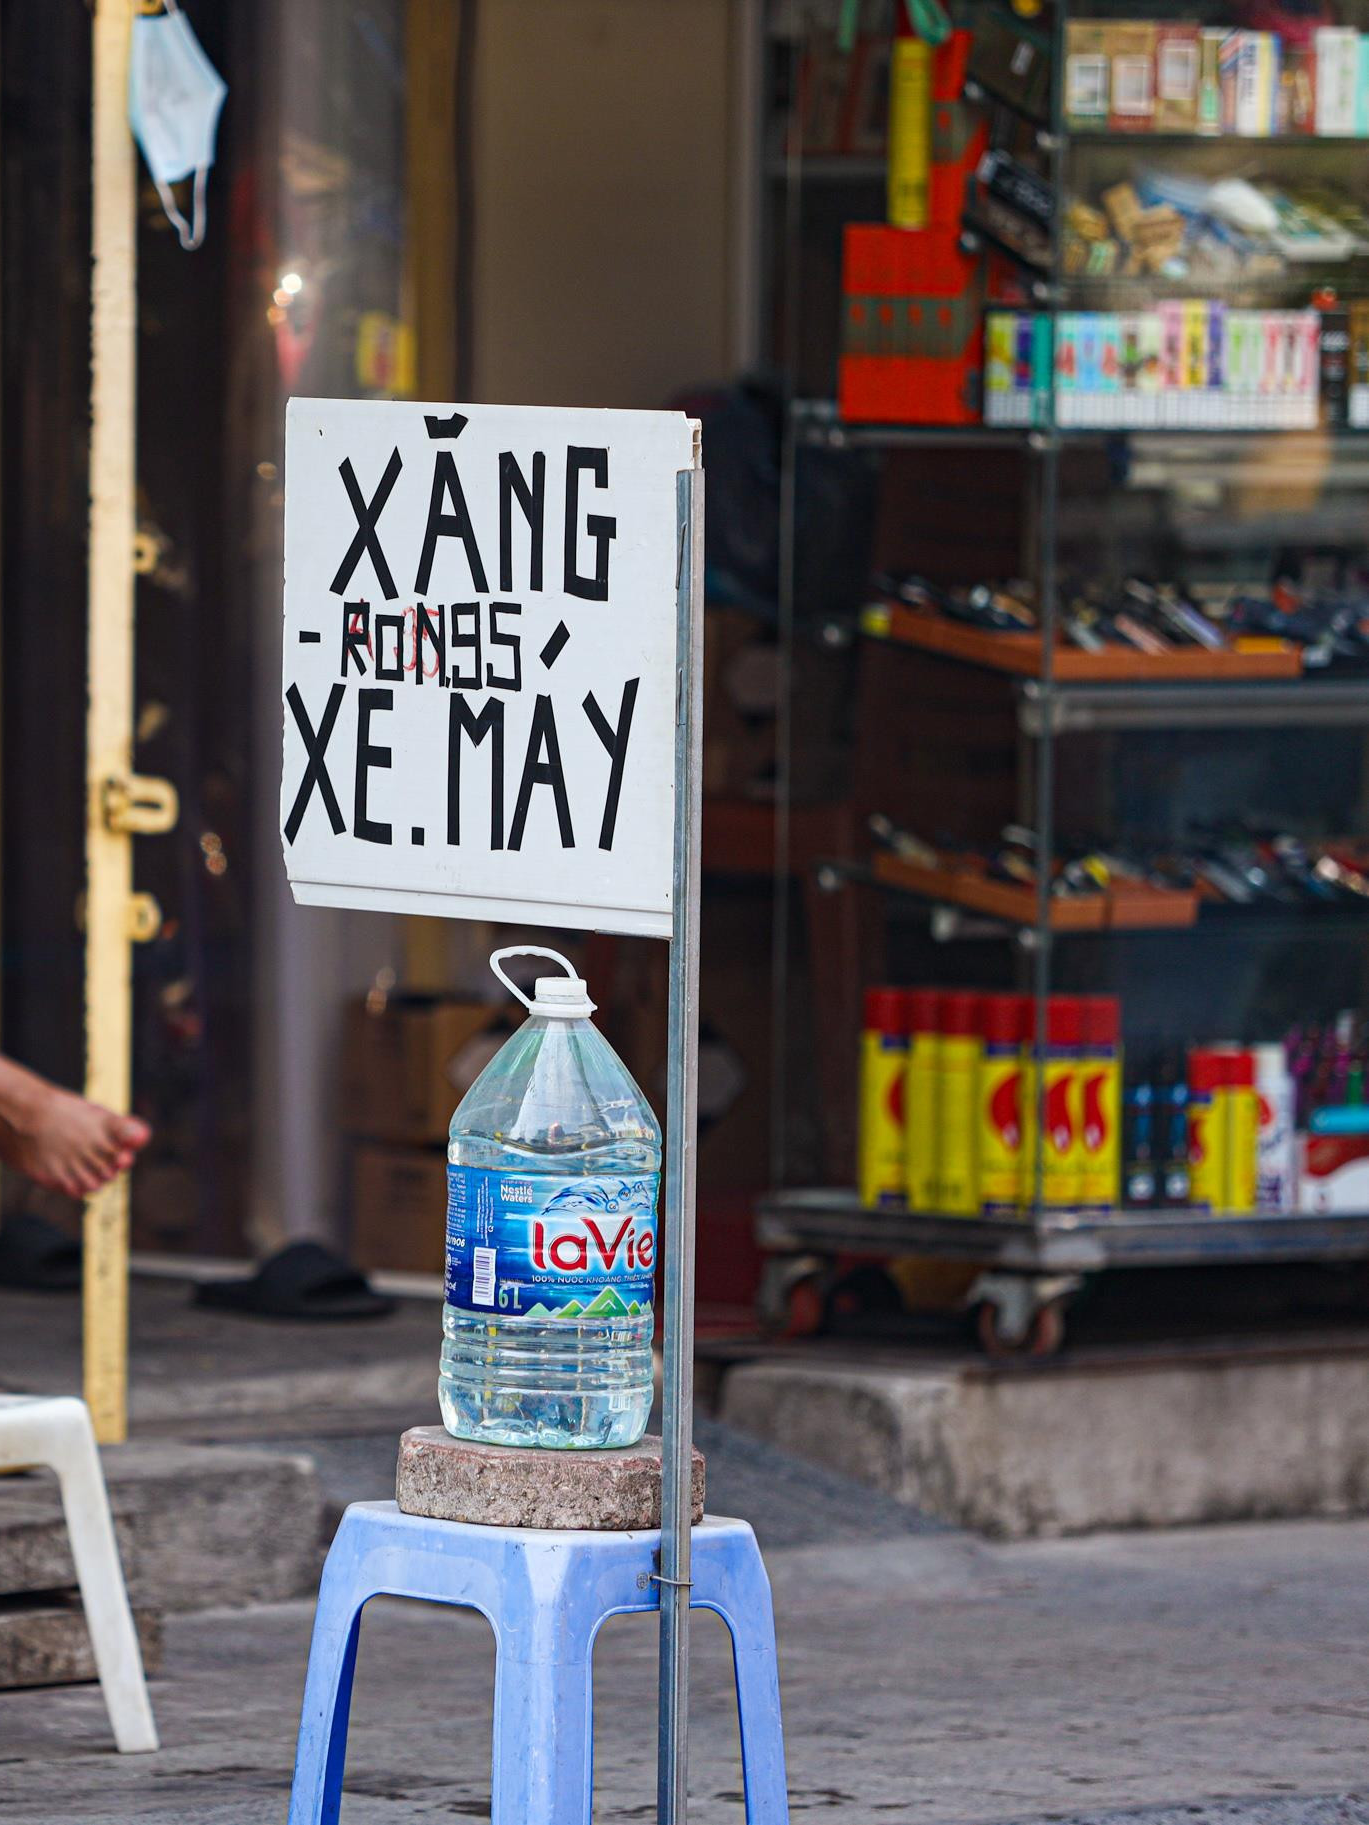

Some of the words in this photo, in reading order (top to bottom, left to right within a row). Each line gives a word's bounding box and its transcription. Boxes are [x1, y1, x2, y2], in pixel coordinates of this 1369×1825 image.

[330, 413, 616, 601] XĂNG
[500, 1184, 533, 1196] Nestlé
[500, 1193, 533, 1203] Waters
[532, 1274, 555, 1283] 100%
